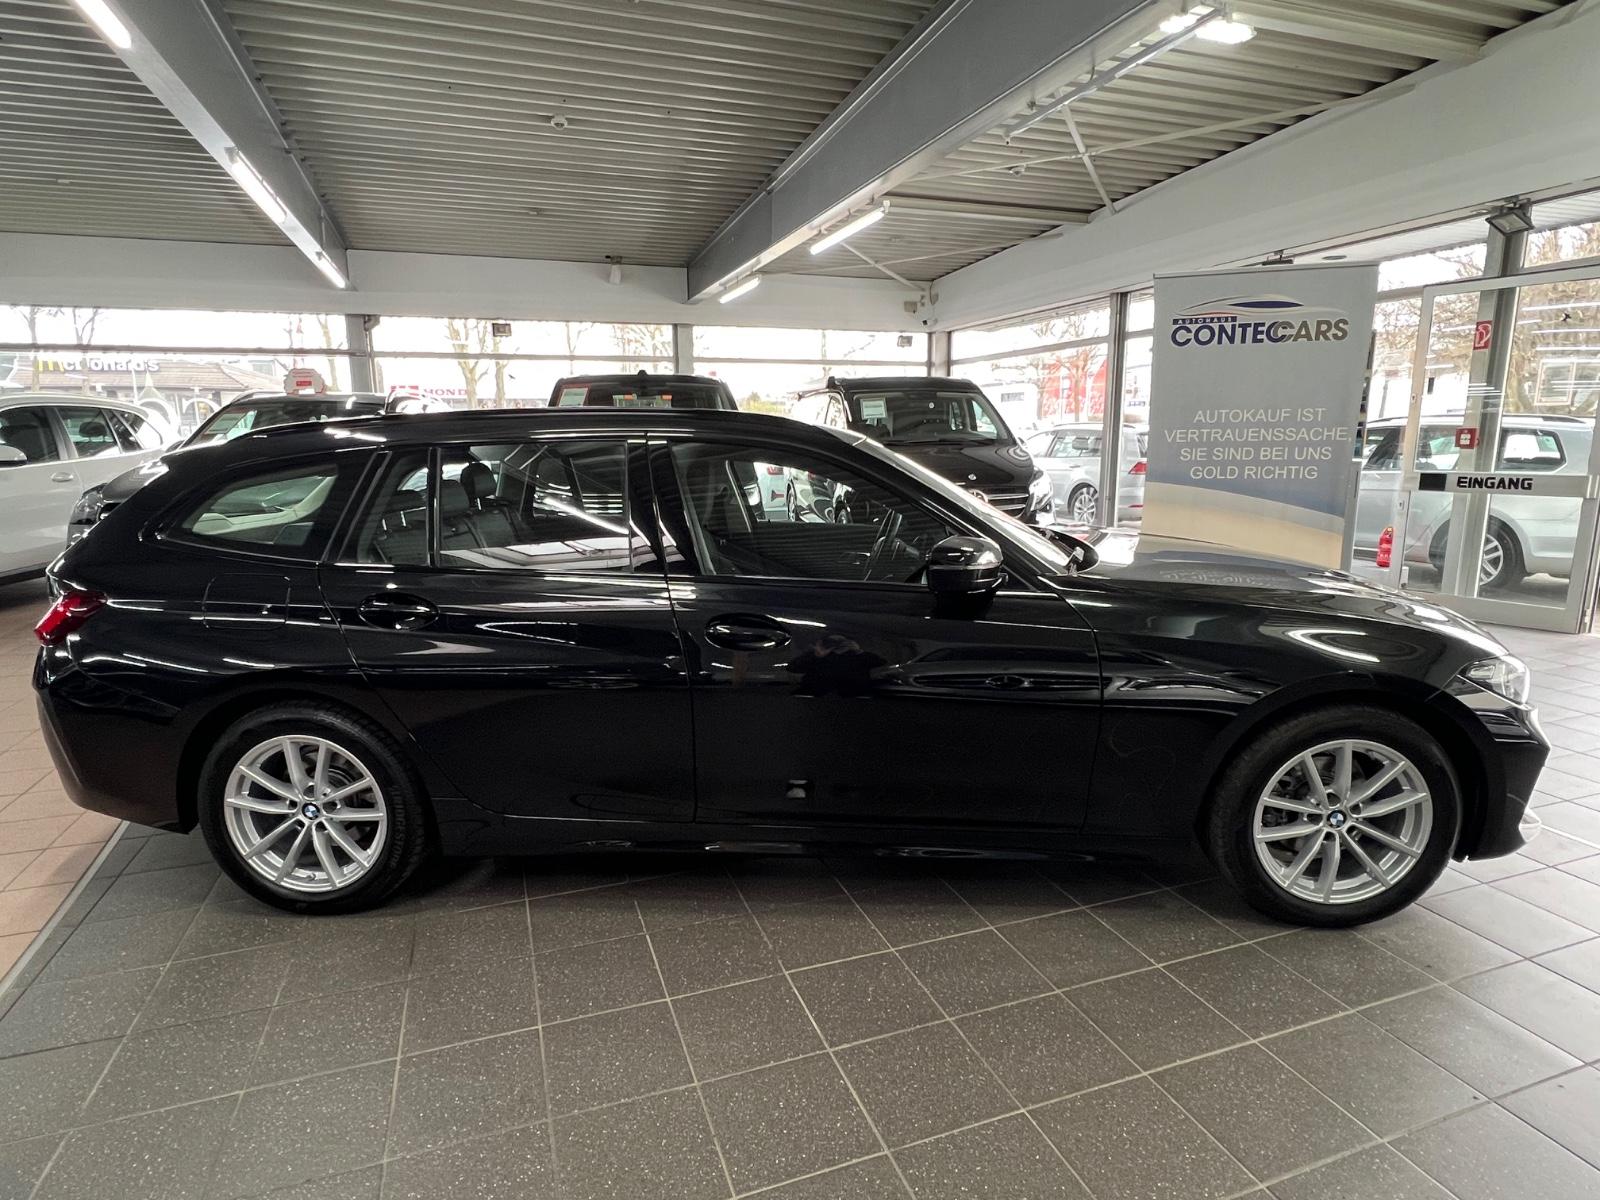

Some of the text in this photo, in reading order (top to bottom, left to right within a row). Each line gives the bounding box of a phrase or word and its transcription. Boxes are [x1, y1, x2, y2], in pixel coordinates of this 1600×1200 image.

[1177, 316, 1232, 325] AUTOHAUS
[423, 388, 472, 396] HOND
[1193, 407, 1327, 424] AUTOKAUF IST
[1179, 446, 1333, 462] SIE SIND BEI UNS
[1190, 465, 1319, 480] GOLD RICHTIG
[1456, 476, 1533, 491] EINGANG
